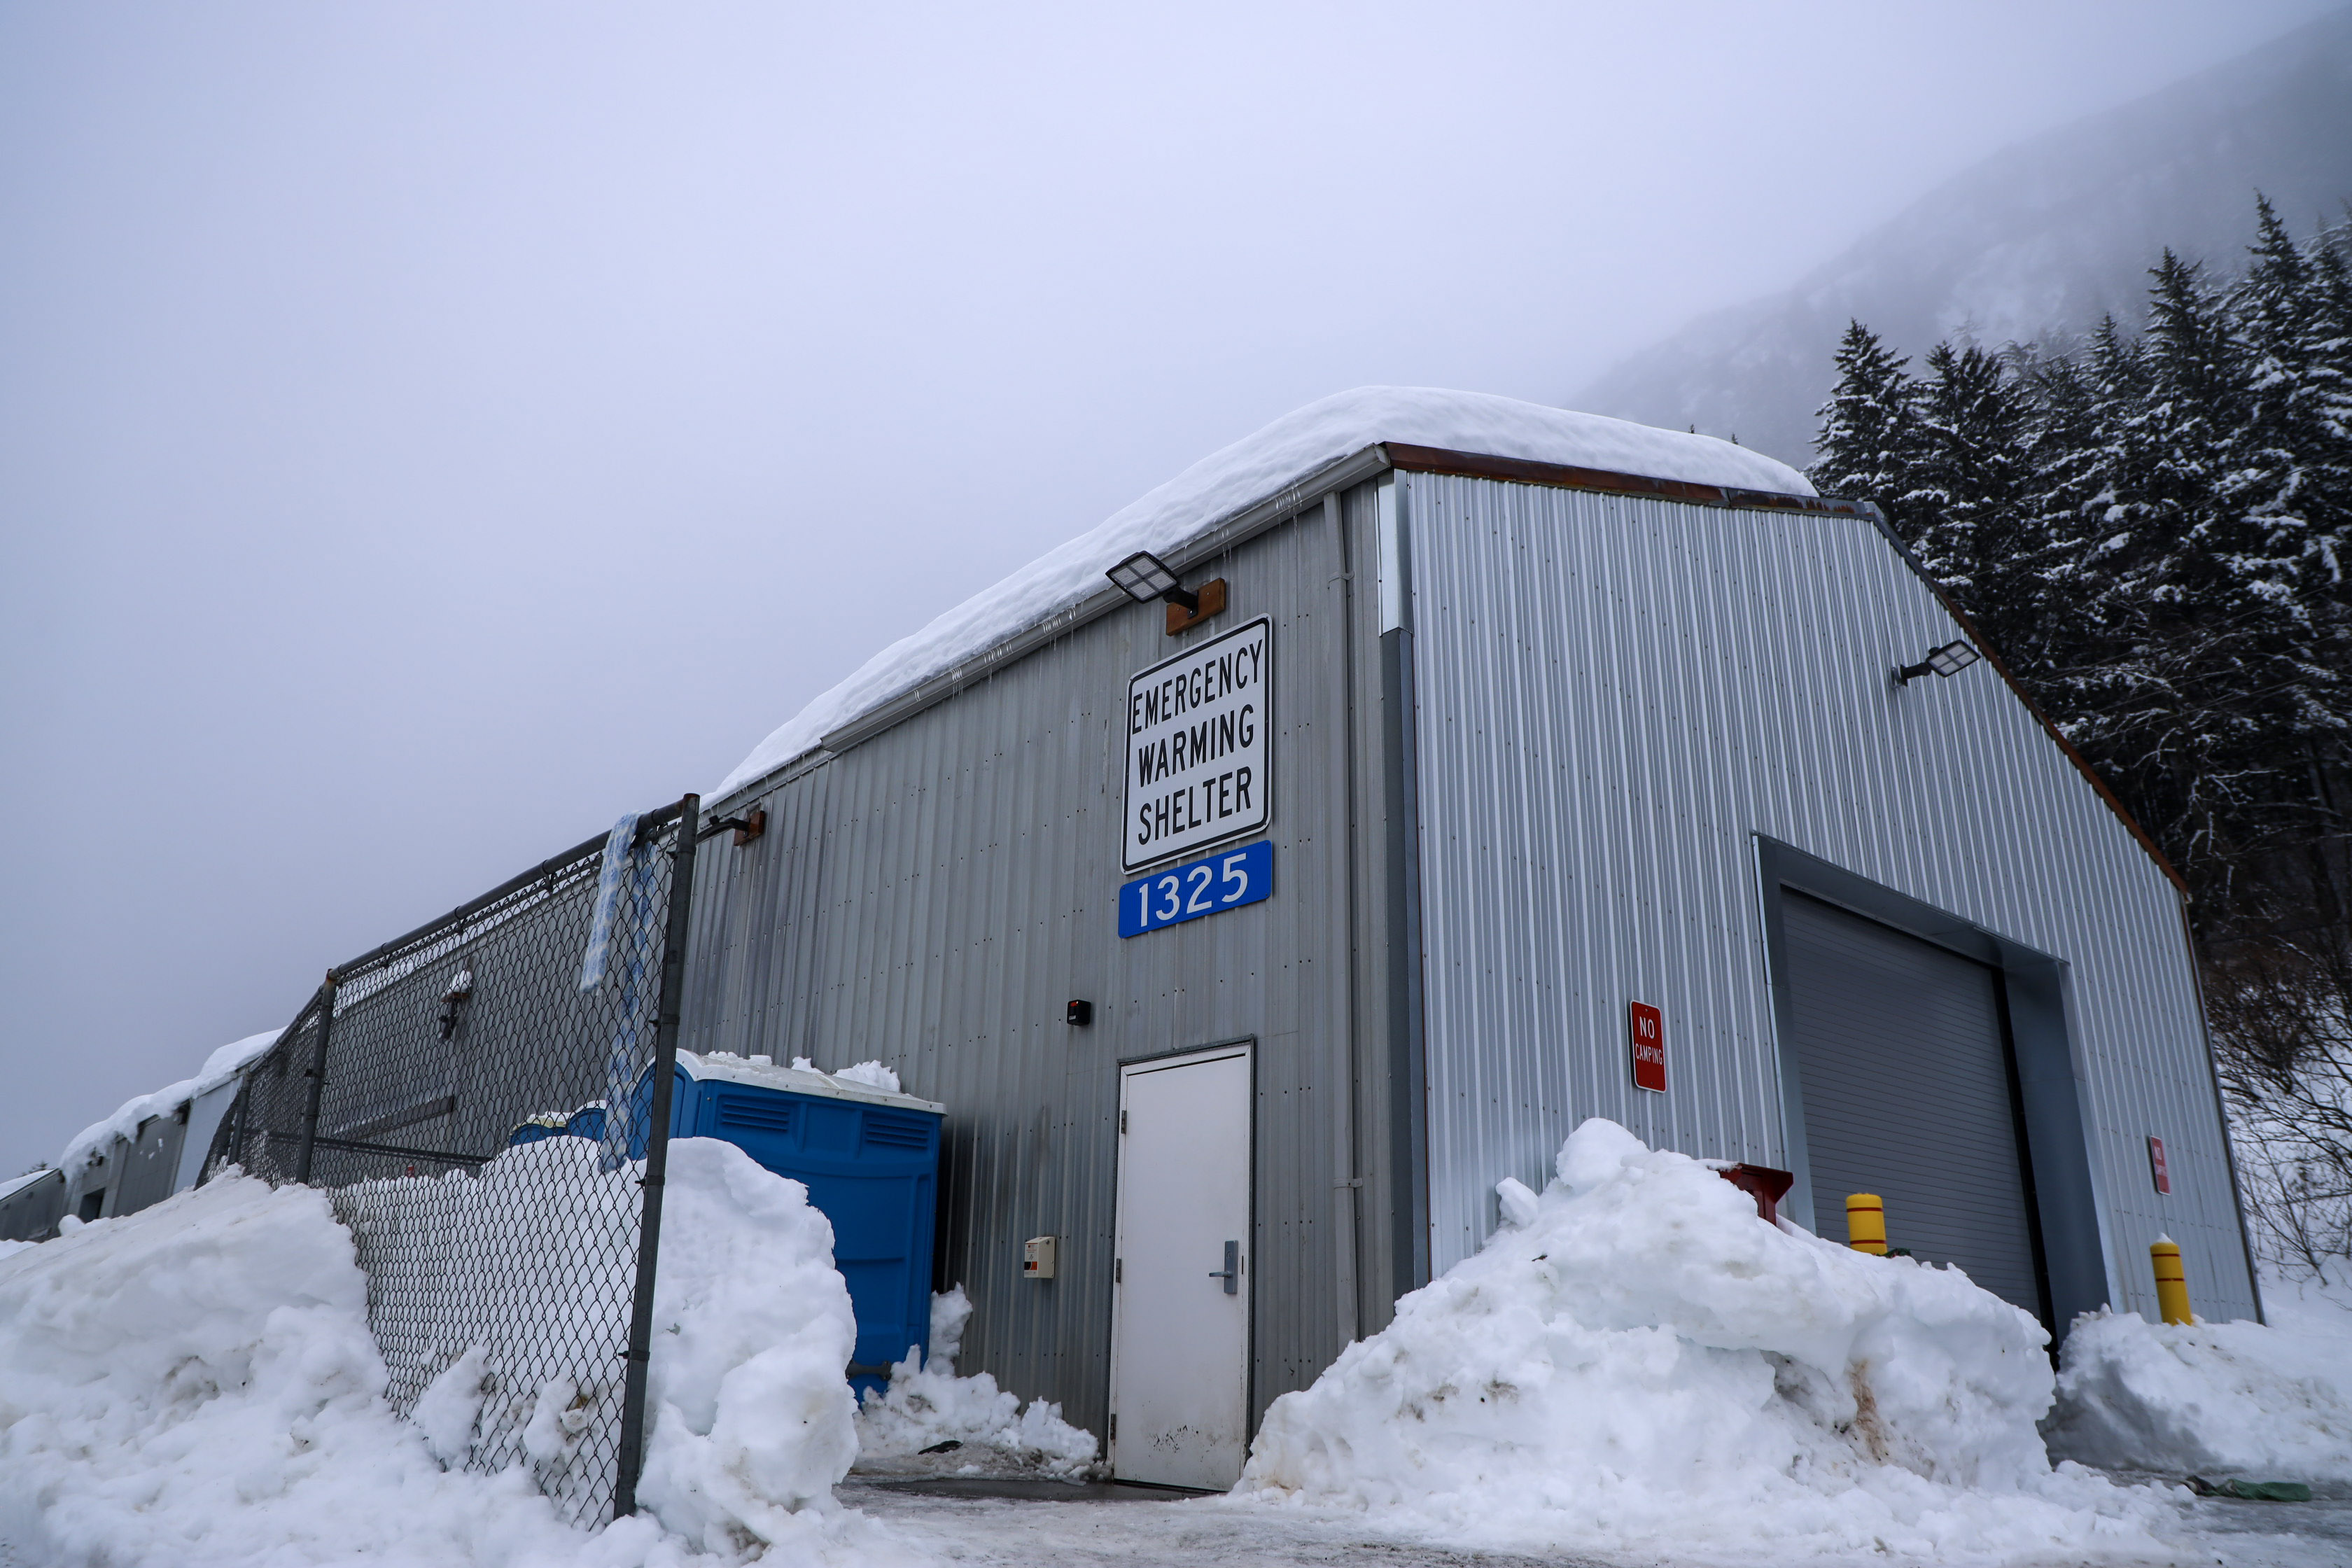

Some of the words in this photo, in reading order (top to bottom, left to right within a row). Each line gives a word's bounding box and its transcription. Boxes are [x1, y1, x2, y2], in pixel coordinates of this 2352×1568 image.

[1131, 638, 1264, 735] EMERGENCY
[1138, 704, 1254, 788] WARMING
[1138, 766, 1252, 846] SHELTER
[1139, 853, 1249, 927] 1325
[1635, 1042, 1663, 1065] CAMPING
[1639, 1016, 1655, 1040] NO
